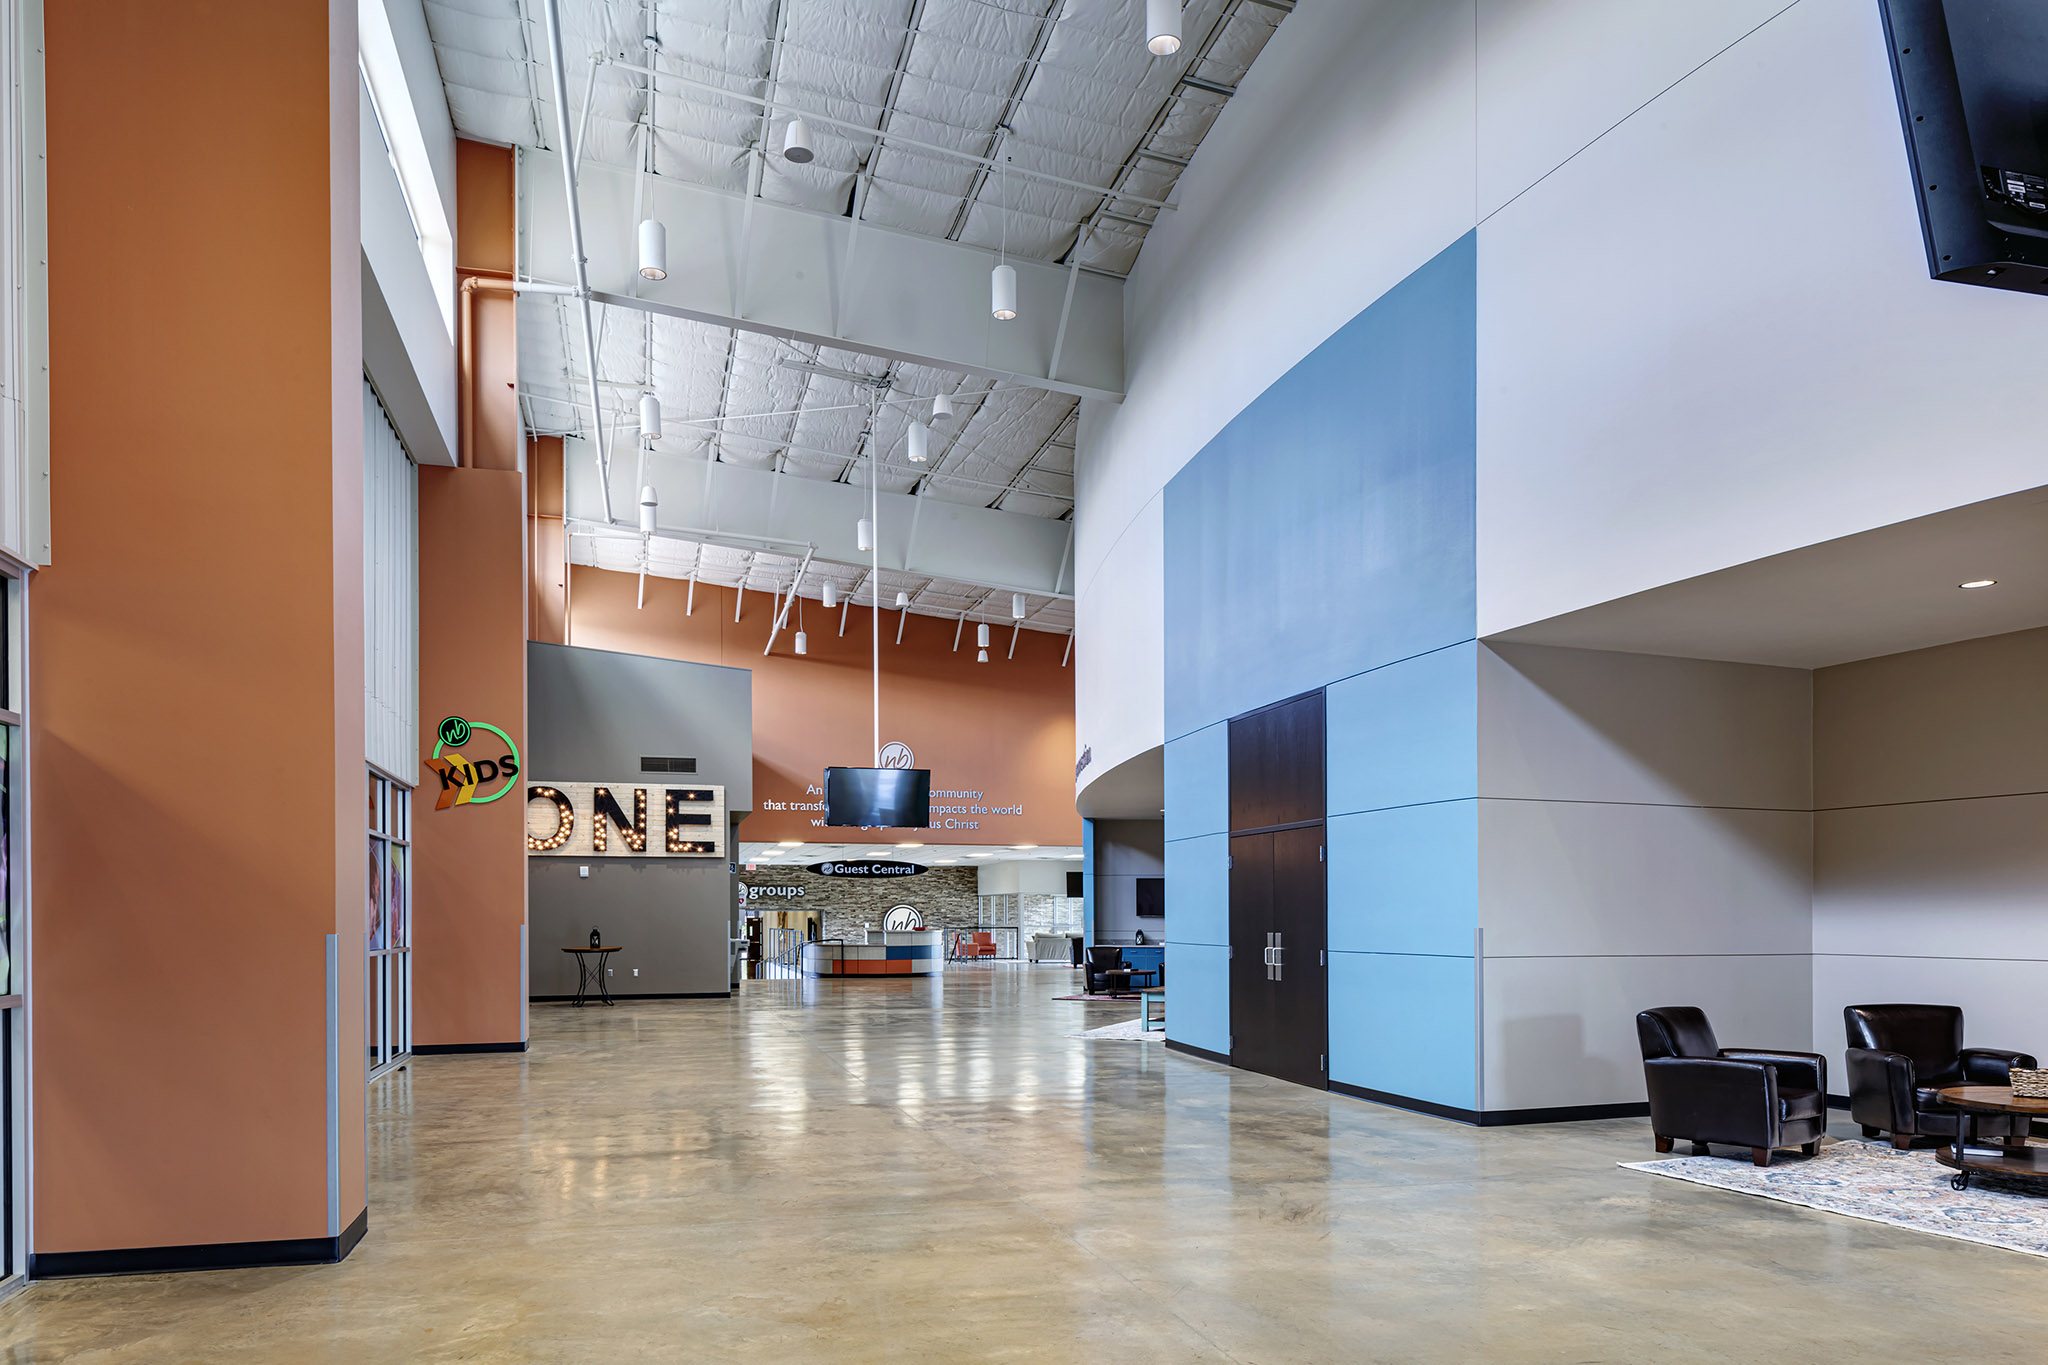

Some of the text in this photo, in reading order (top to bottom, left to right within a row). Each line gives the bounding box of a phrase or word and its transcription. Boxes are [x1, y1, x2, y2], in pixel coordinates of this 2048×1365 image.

[438, 754, 519, 791] KIDS
[805, 783, 984, 802] An ommunity
[763, 799, 1023, 817] that transf mpacts the world
[528, 786, 715, 852] ONE
[810, 816, 828, 827] wi
[929, 820, 942, 830] us
[944, 818, 980, 830] Christ
[834, 863, 869, 875] Guest
[871, 863, 915, 875] Central
[749, 885, 806, 900] groups
